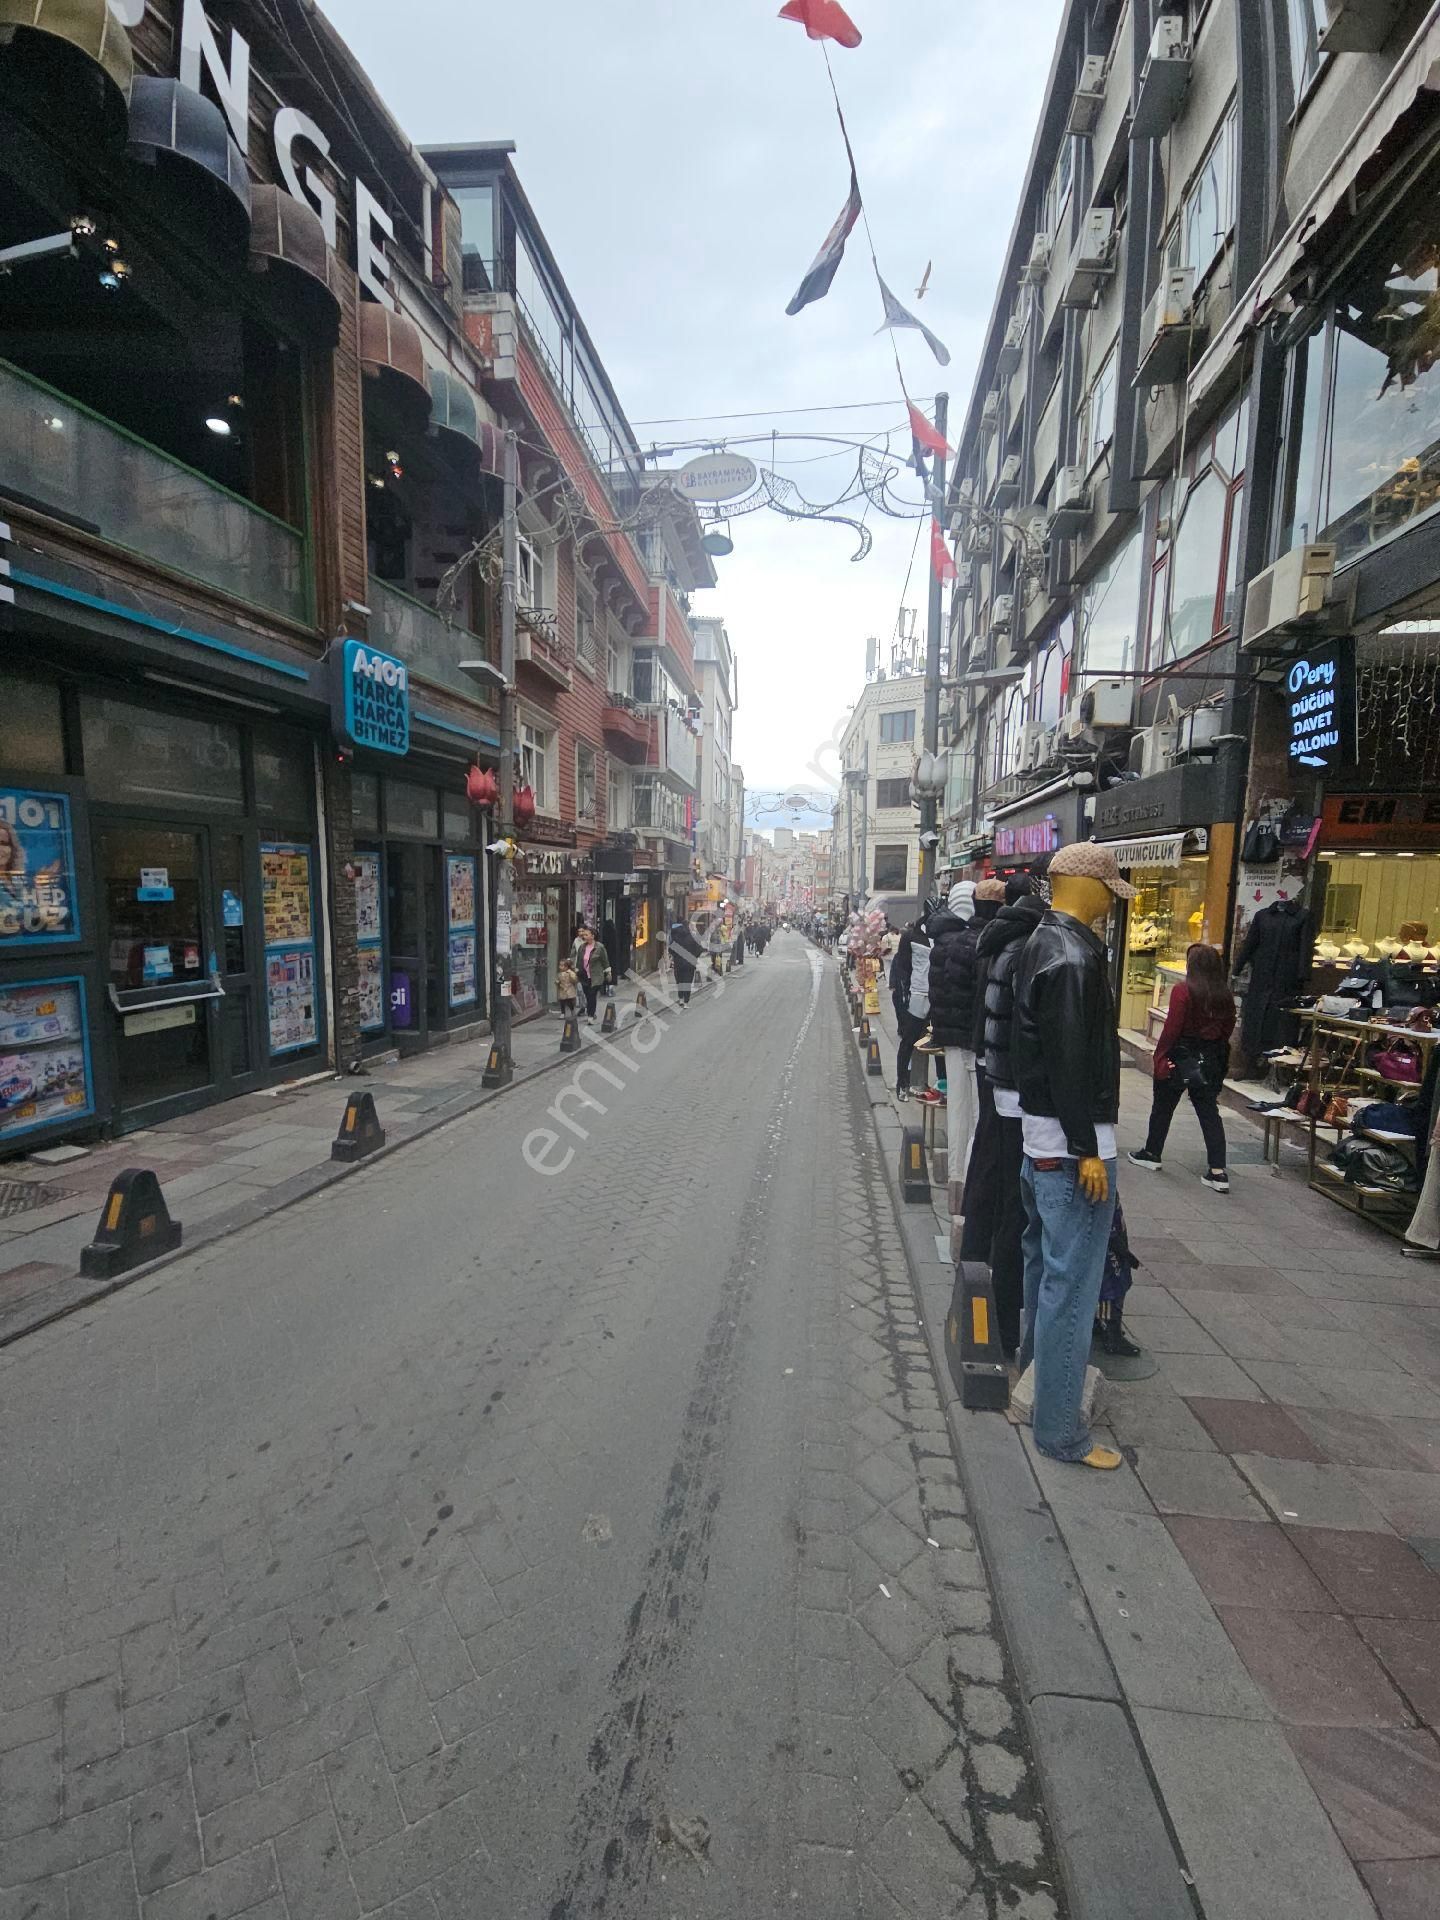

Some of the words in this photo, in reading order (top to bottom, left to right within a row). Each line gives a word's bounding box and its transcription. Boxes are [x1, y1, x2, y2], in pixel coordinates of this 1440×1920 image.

[1289, 659, 1336, 692] Pery
[353, 672, 405, 711] HARCA
[1292, 689, 1335, 717] DÜĞÜN
[353, 696, 405, 731] HARCA
[1293, 711, 1333, 736] DAVET
[1290, 730, 1339, 756] SALONU
[1114, 842, 1176, 863] KUYUMCULUK
